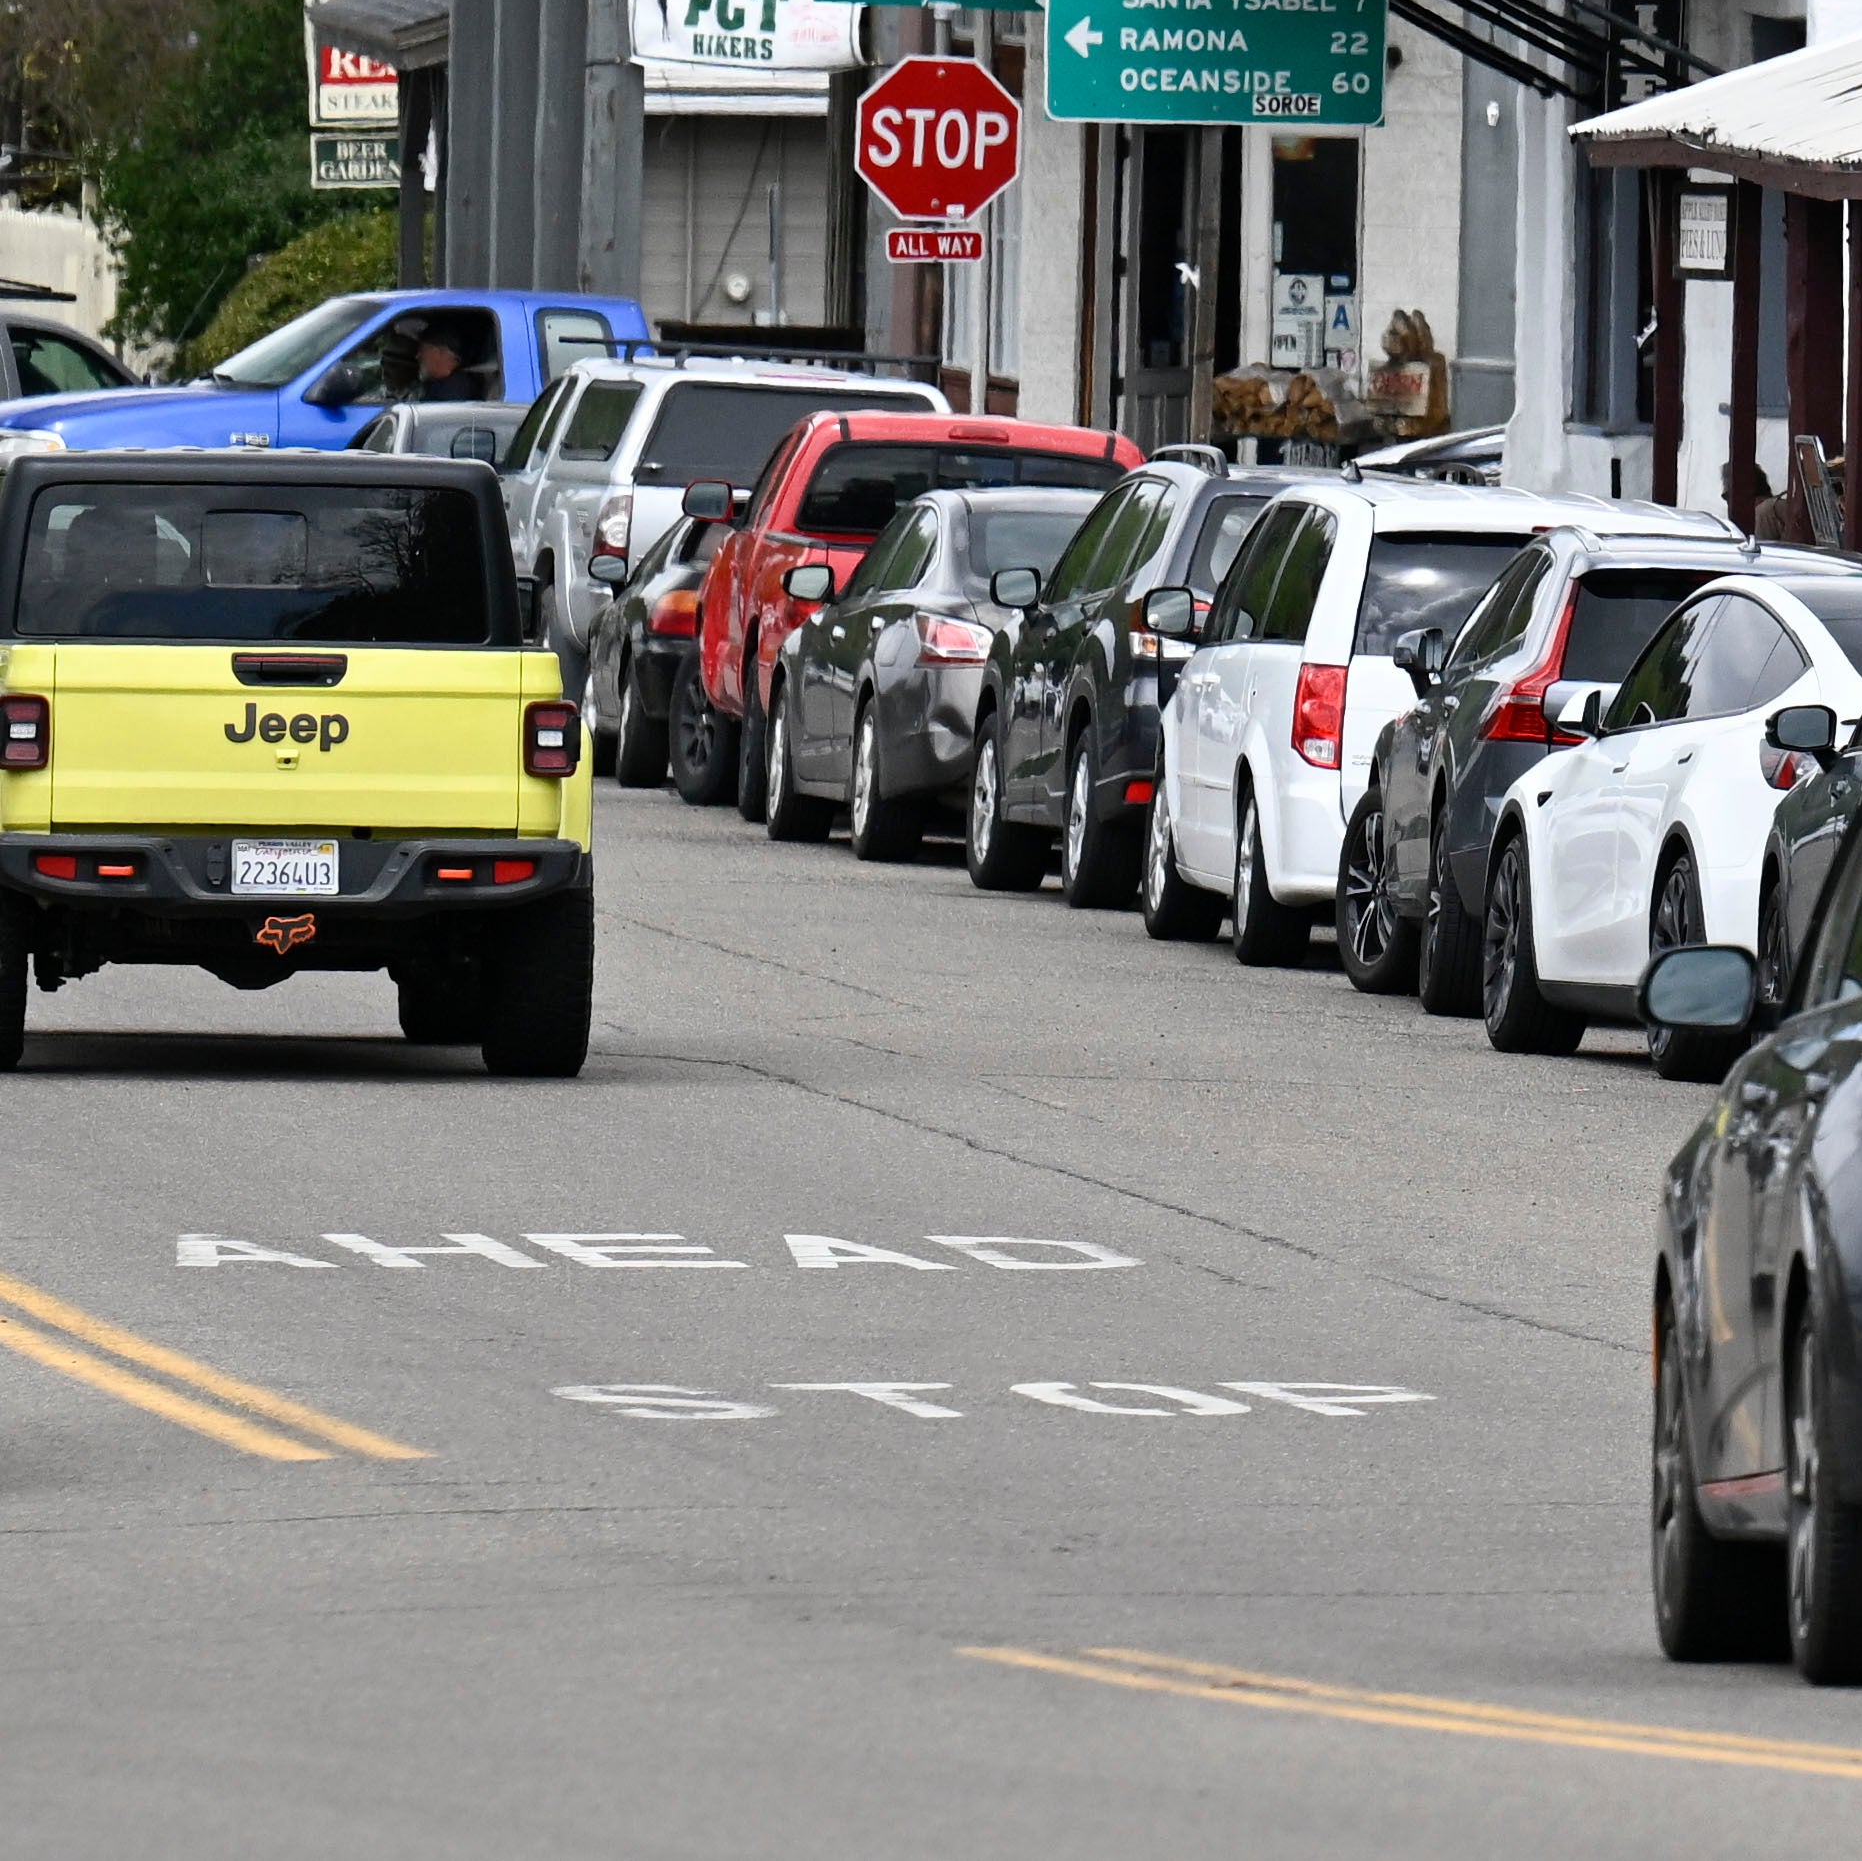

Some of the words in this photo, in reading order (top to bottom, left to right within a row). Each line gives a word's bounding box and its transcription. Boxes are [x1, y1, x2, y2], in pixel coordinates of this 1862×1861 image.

[692, 33, 774, 61] HIKERS
[1119, 27, 1249, 52] RAMONA
[1330, 32, 1370, 55] 22
[1120, 68, 1292, 95] OCEANSIDE
[1331, 72, 1371, 95] 60
[336, 140, 387, 160] BEER
[867, 106, 1010, 171] STOP
[319, 159, 401, 181] GARDEN
[895, 235, 929, 256] ALL
[937, 236, 975, 257] WAY
[1332, 303, 1351, 331] A
[223, 702, 350, 752] Jeep
[239, 860, 332, 886] 22364U3
[174, 1231, 1147, 1270] AHEAD
[553, 1380, 1439, 1421] STOP
